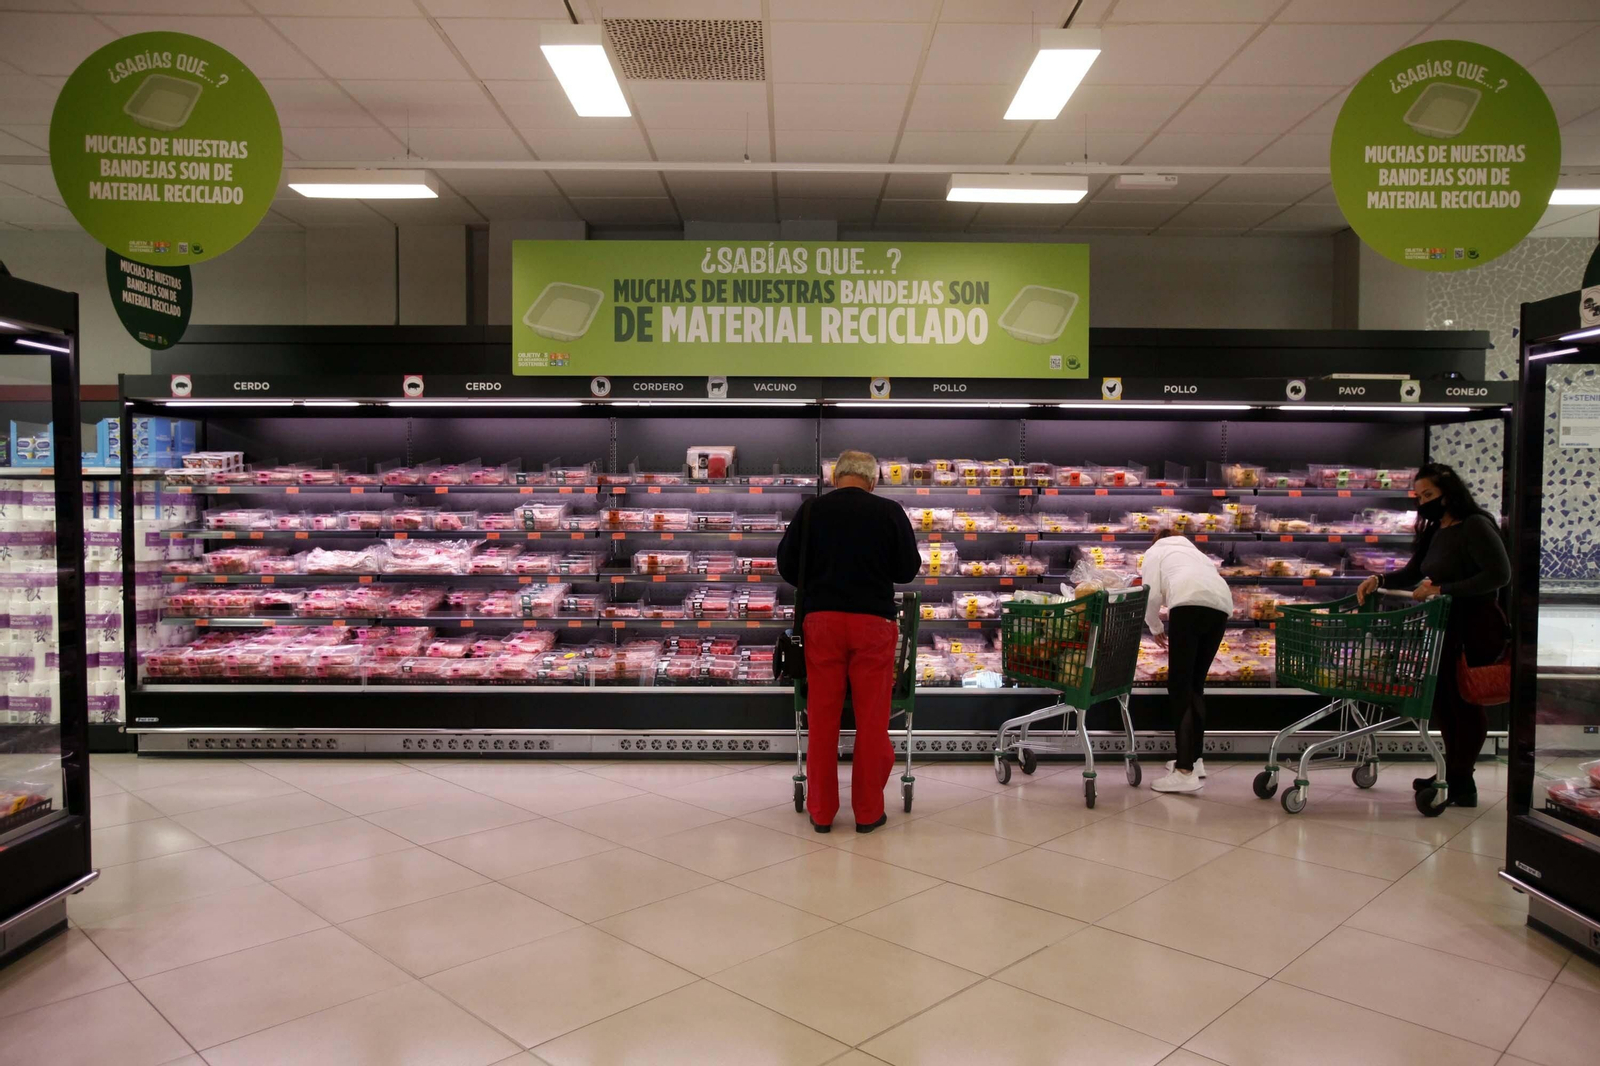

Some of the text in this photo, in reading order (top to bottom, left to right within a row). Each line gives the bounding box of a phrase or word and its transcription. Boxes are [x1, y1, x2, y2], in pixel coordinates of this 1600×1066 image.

[109, 49, 172, 84] ¿SABÍAS
[1390, 59, 1453, 94] ¿SABÍAS
[85, 135, 248, 159] MUCHAS DE NUESTRAS
[1365, 144, 1525, 163] MUCHAS DE NUESTRAS
[100, 159, 233, 182] BANDEJAS SON DE
[1379, 168, 1510, 186] BANDEJAS SON DE
[89, 182, 243, 205] MATERIAL RECICLADO
[1367, 190, 1521, 209] MATERIAL RECICLADO
[700, 241, 808, 276] ¿SABÍAS
[120, 259, 182, 290] MUCHAS DE NUESTRAS
[126, 276, 177, 303] BANDEJAS SON DE
[613, 279, 990, 305] MUCHAS DE NUESTRAS BANDEJAS SON
[122, 289, 181, 318] MATERIAL RECICLADO
[613, 306, 989, 345] DE MATERIAL RECICLADO
[233, 381, 270, 391] CERDO
[465, 381, 502, 391] CERDO
[632, 381, 684, 391] CORDERO
[753, 382, 797, 392] VACUNO
[933, 383, 967, 393] POLLO
[1163, 384, 1198, 394] POLLO
[1338, 386, 1366, 395] PAVO
[1445, 387, 1488, 396] CONEJO
